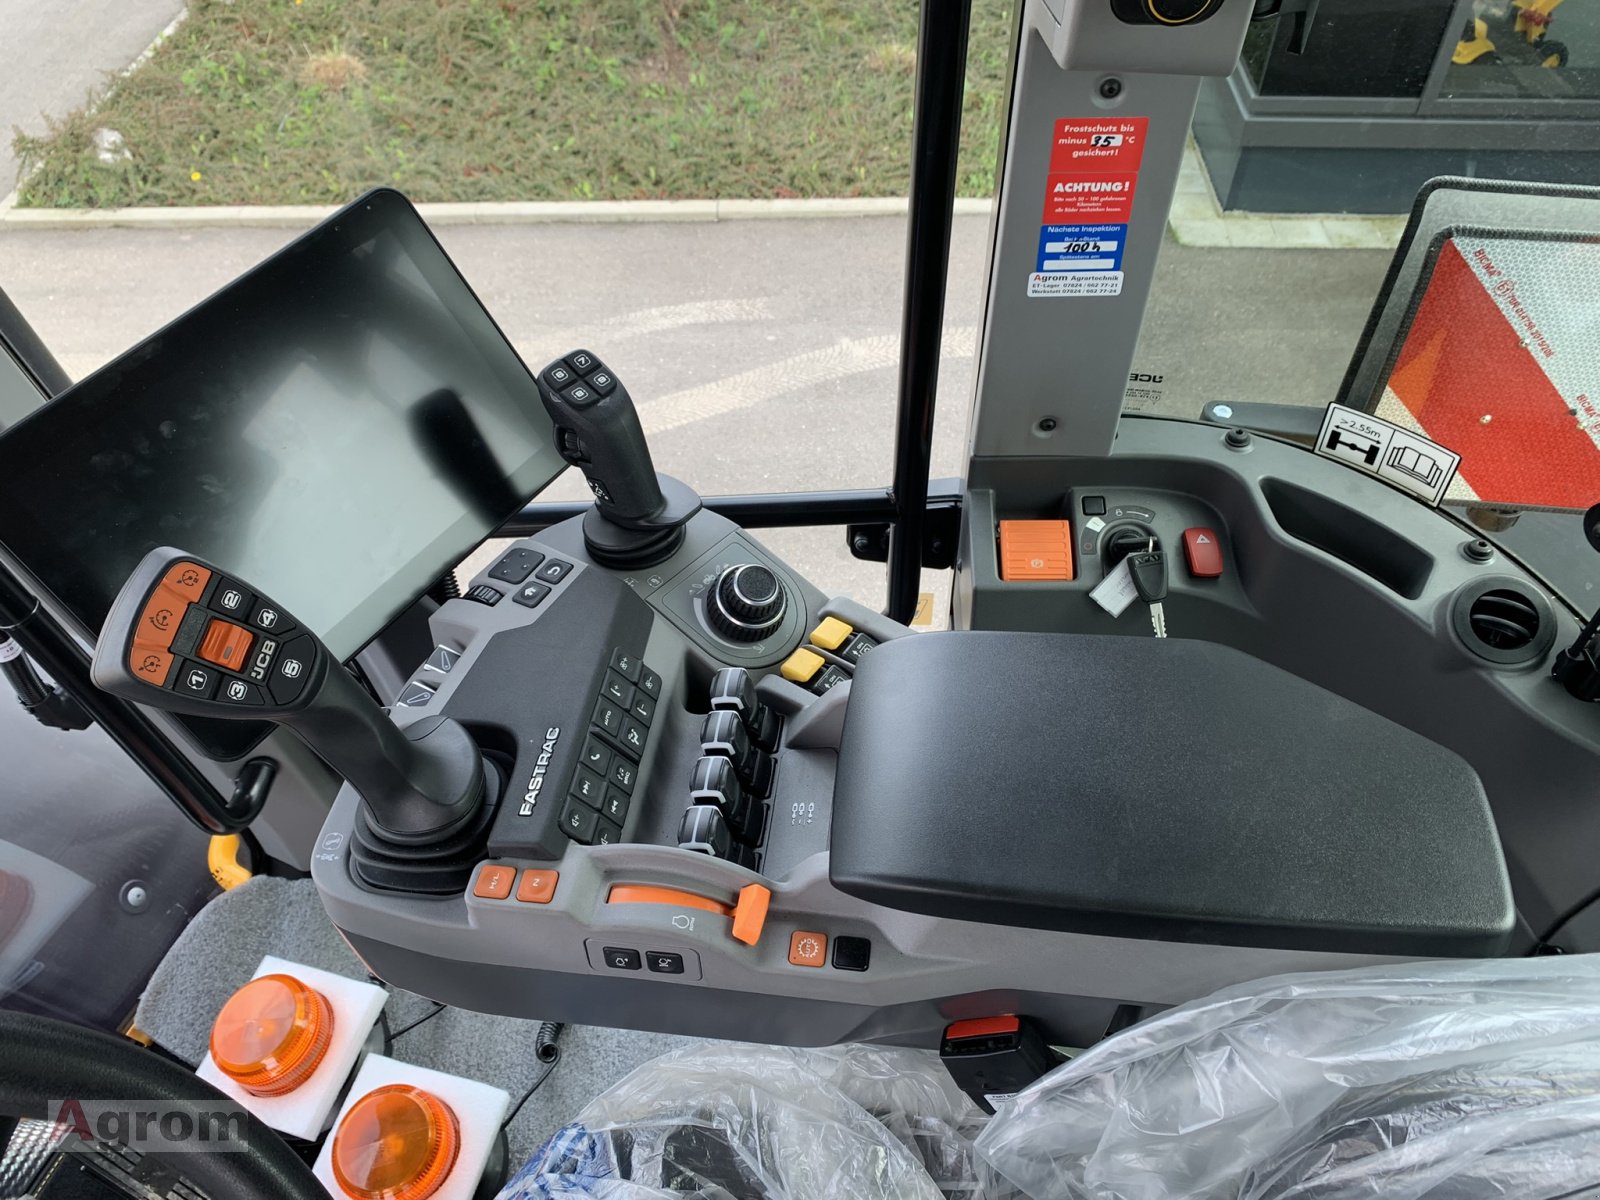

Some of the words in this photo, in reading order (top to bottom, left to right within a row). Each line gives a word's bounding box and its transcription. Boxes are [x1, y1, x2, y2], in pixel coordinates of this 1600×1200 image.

[1064, 124, 1118, 133] Frostschutz
[1120, 123, 1135, 132] bis
[1091, 135, 1116, 147] 35
[1072, 149, 1119, 158] gesichert!
[1053, 182, 1130, 193] ACHTUNG!
[1081, 225, 1121, 233] Inspektion
[1064, 240, 1090, 253] 100
[1033, 274, 1068, 282] Agrom
[223, 591, 239, 608] 2
[262, 611, 275, 626] 4
[250, 640, 276, 681] JCB
[285, 662, 299, 676] 5
[190, 672, 205, 687] 1
[231, 683, 245, 698] 3
[518, 727, 560, 816] FASTRAC
[488, 872, 500, 890] H/L
